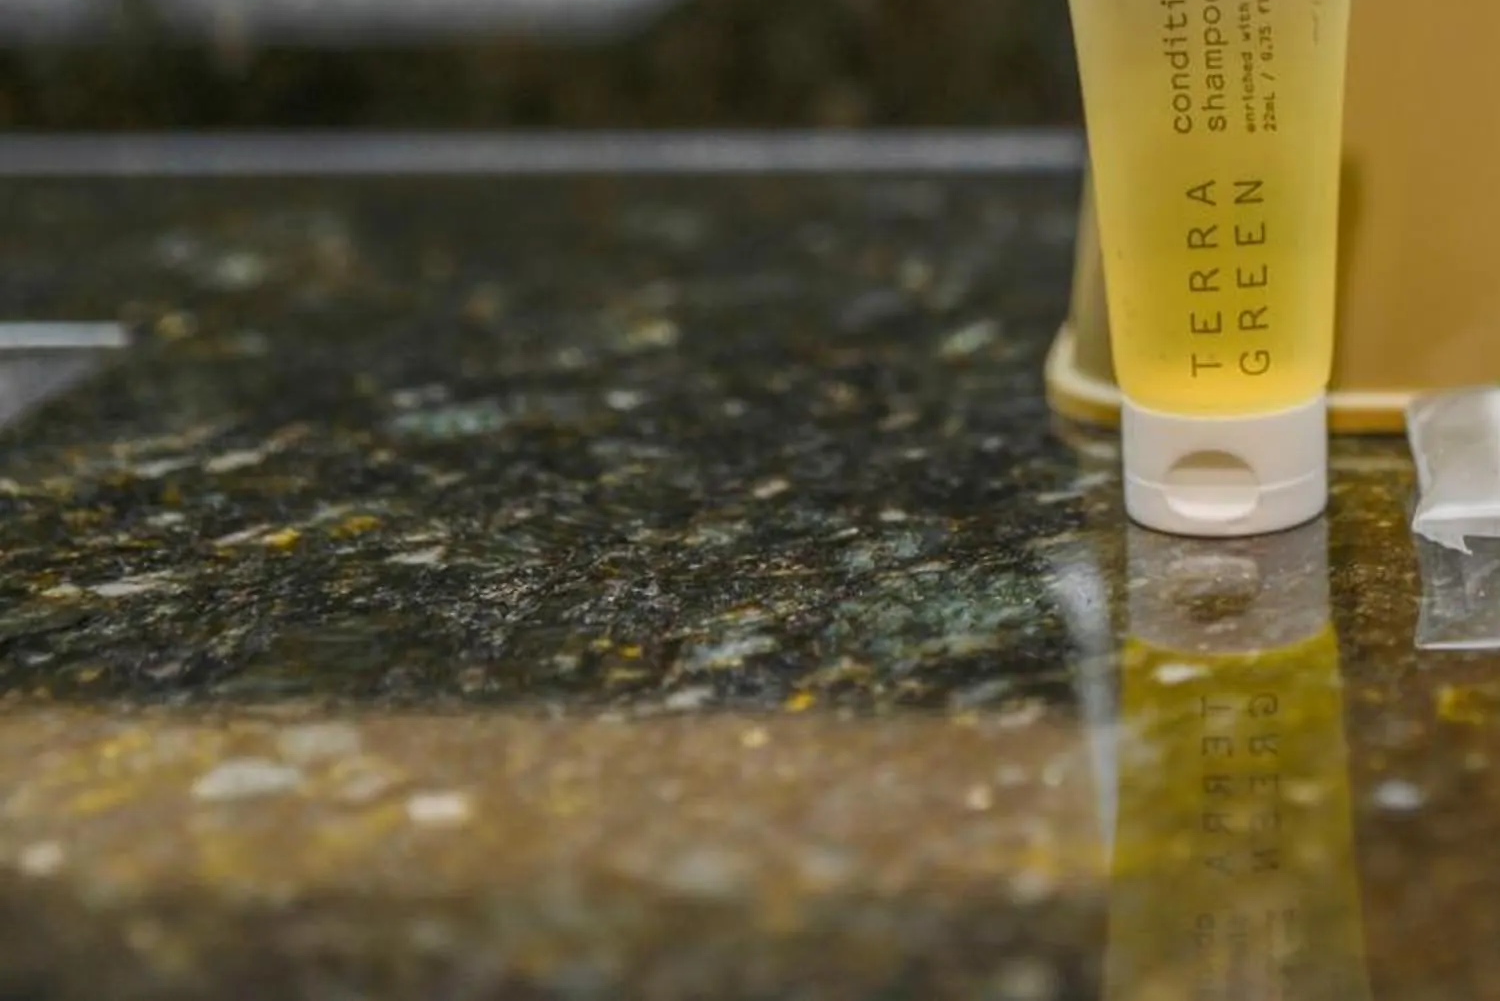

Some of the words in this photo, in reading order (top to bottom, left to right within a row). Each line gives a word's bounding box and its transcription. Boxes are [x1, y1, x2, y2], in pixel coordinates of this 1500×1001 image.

[1238, 2, 1251, 42] with
[1241, 51, 1256, 133] enriched
[1186, 179, 1223, 377] TERRA
[1233, 180, 1270, 376] GREEN
